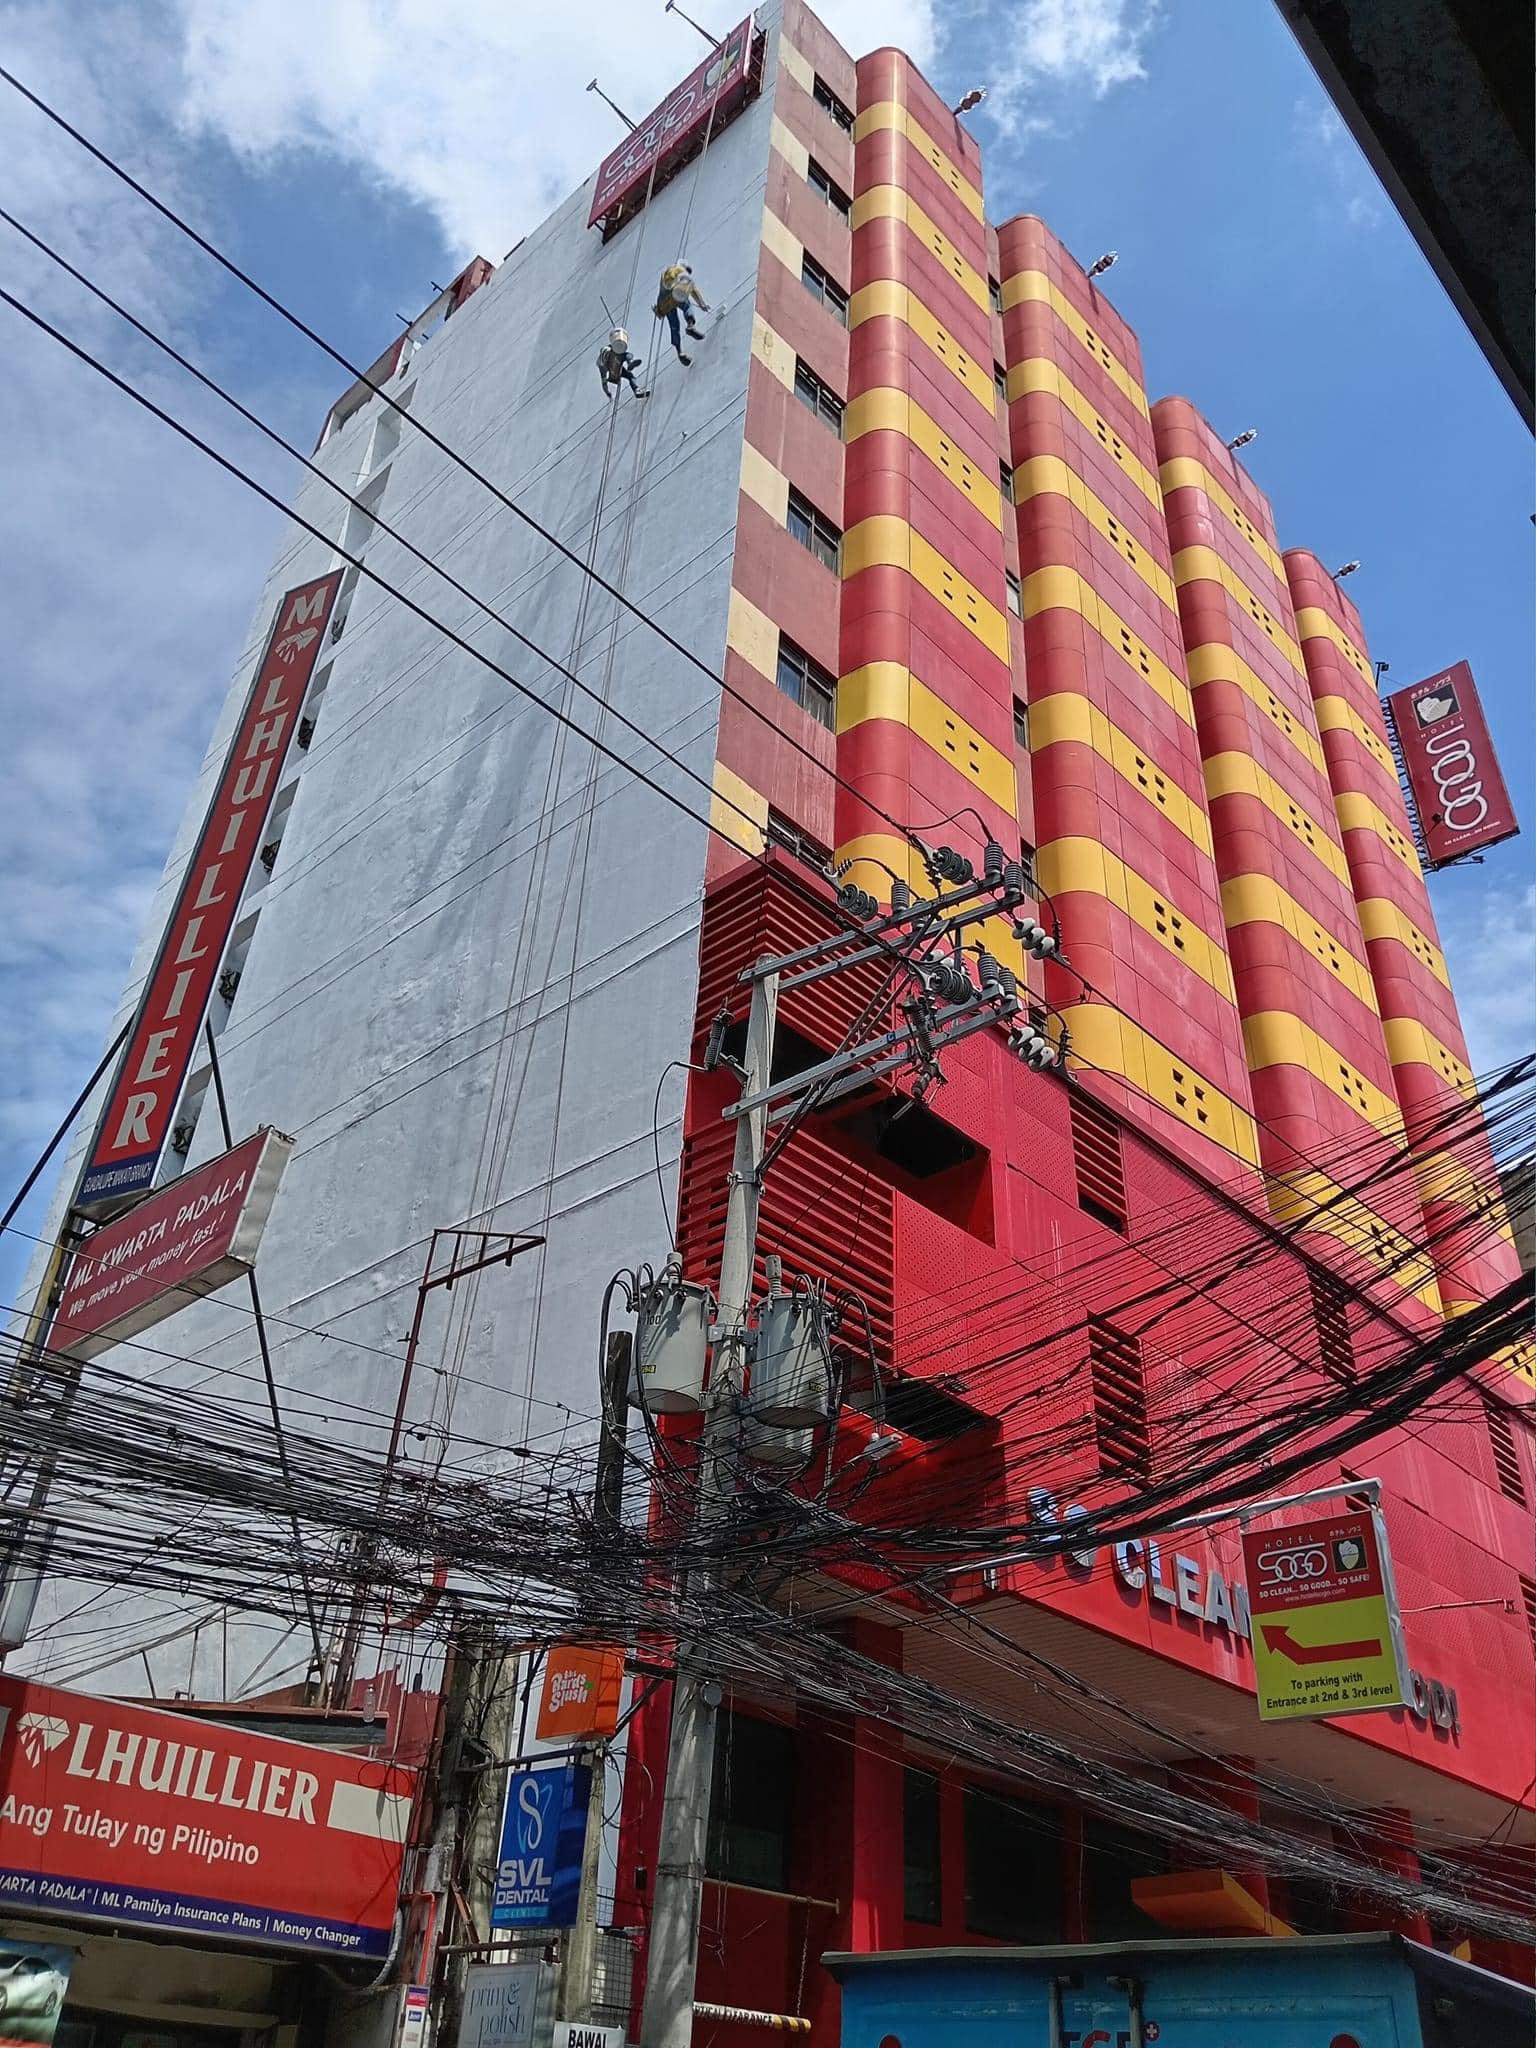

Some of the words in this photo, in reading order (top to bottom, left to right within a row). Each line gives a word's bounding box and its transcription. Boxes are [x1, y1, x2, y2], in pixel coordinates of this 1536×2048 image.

[111, 674, 289, 1149] LHUILLIER
[70, 1266, 93, 1292] ML
[97, 1218, 168, 1276] KWARTA
[172, 1170, 247, 1232] PADALA
[68, 1300, 84, 1319] We
[87, 1283, 117, 1307] move
[116, 1263, 147, 1294] your
[146, 1240, 187, 1273] money
[189, 1211, 226, 1249] fast!
[1258, 1542, 1328, 1586] SOGO
[1264, 1534, 1313, 1550] HOTEL
[1260, 1591, 1269, 1599] SO
[1300, 1583, 1310, 1592] SO
[1338, 1577, 1348, 1586] SO
[1266, 1694, 1309, 1710] Entrance
[1310, 1694, 1320, 1704] at
[1322, 1690, 1340, 1702] 2nd
[1342, 1689, 1350, 1700] &
[1351, 1686, 1368, 1698] 3rd
[1370, 1683, 1393, 1696] level
[1291, 1679, 1303, 1691] To
[1304, 1675, 1341, 1692] parking
[1342, 1671, 1364, 1685] with
[66, 1723, 320, 1825] LHUILLIER
[0, 1794, 53, 1836] Ang
[63, 1803, 128, 1848] Tulay
[133, 1823, 166, 1855] ng
[172, 1824, 260, 1866] Pilipino
[498, 1858, 551, 1888] SVL
[0, 1874, 35, 1893] ARTA
[101, 1892, 120, 1908] ML
[124, 1895, 171, 1918] Pamilya
[174, 1902, 229, 1924] Insurance
[231, 1912, 261, 1930] Plans
[272, 1918, 313, 1941] Money
[315, 1926, 361, 1947] Changer
[496, 1887, 549, 1905] DENTAL
